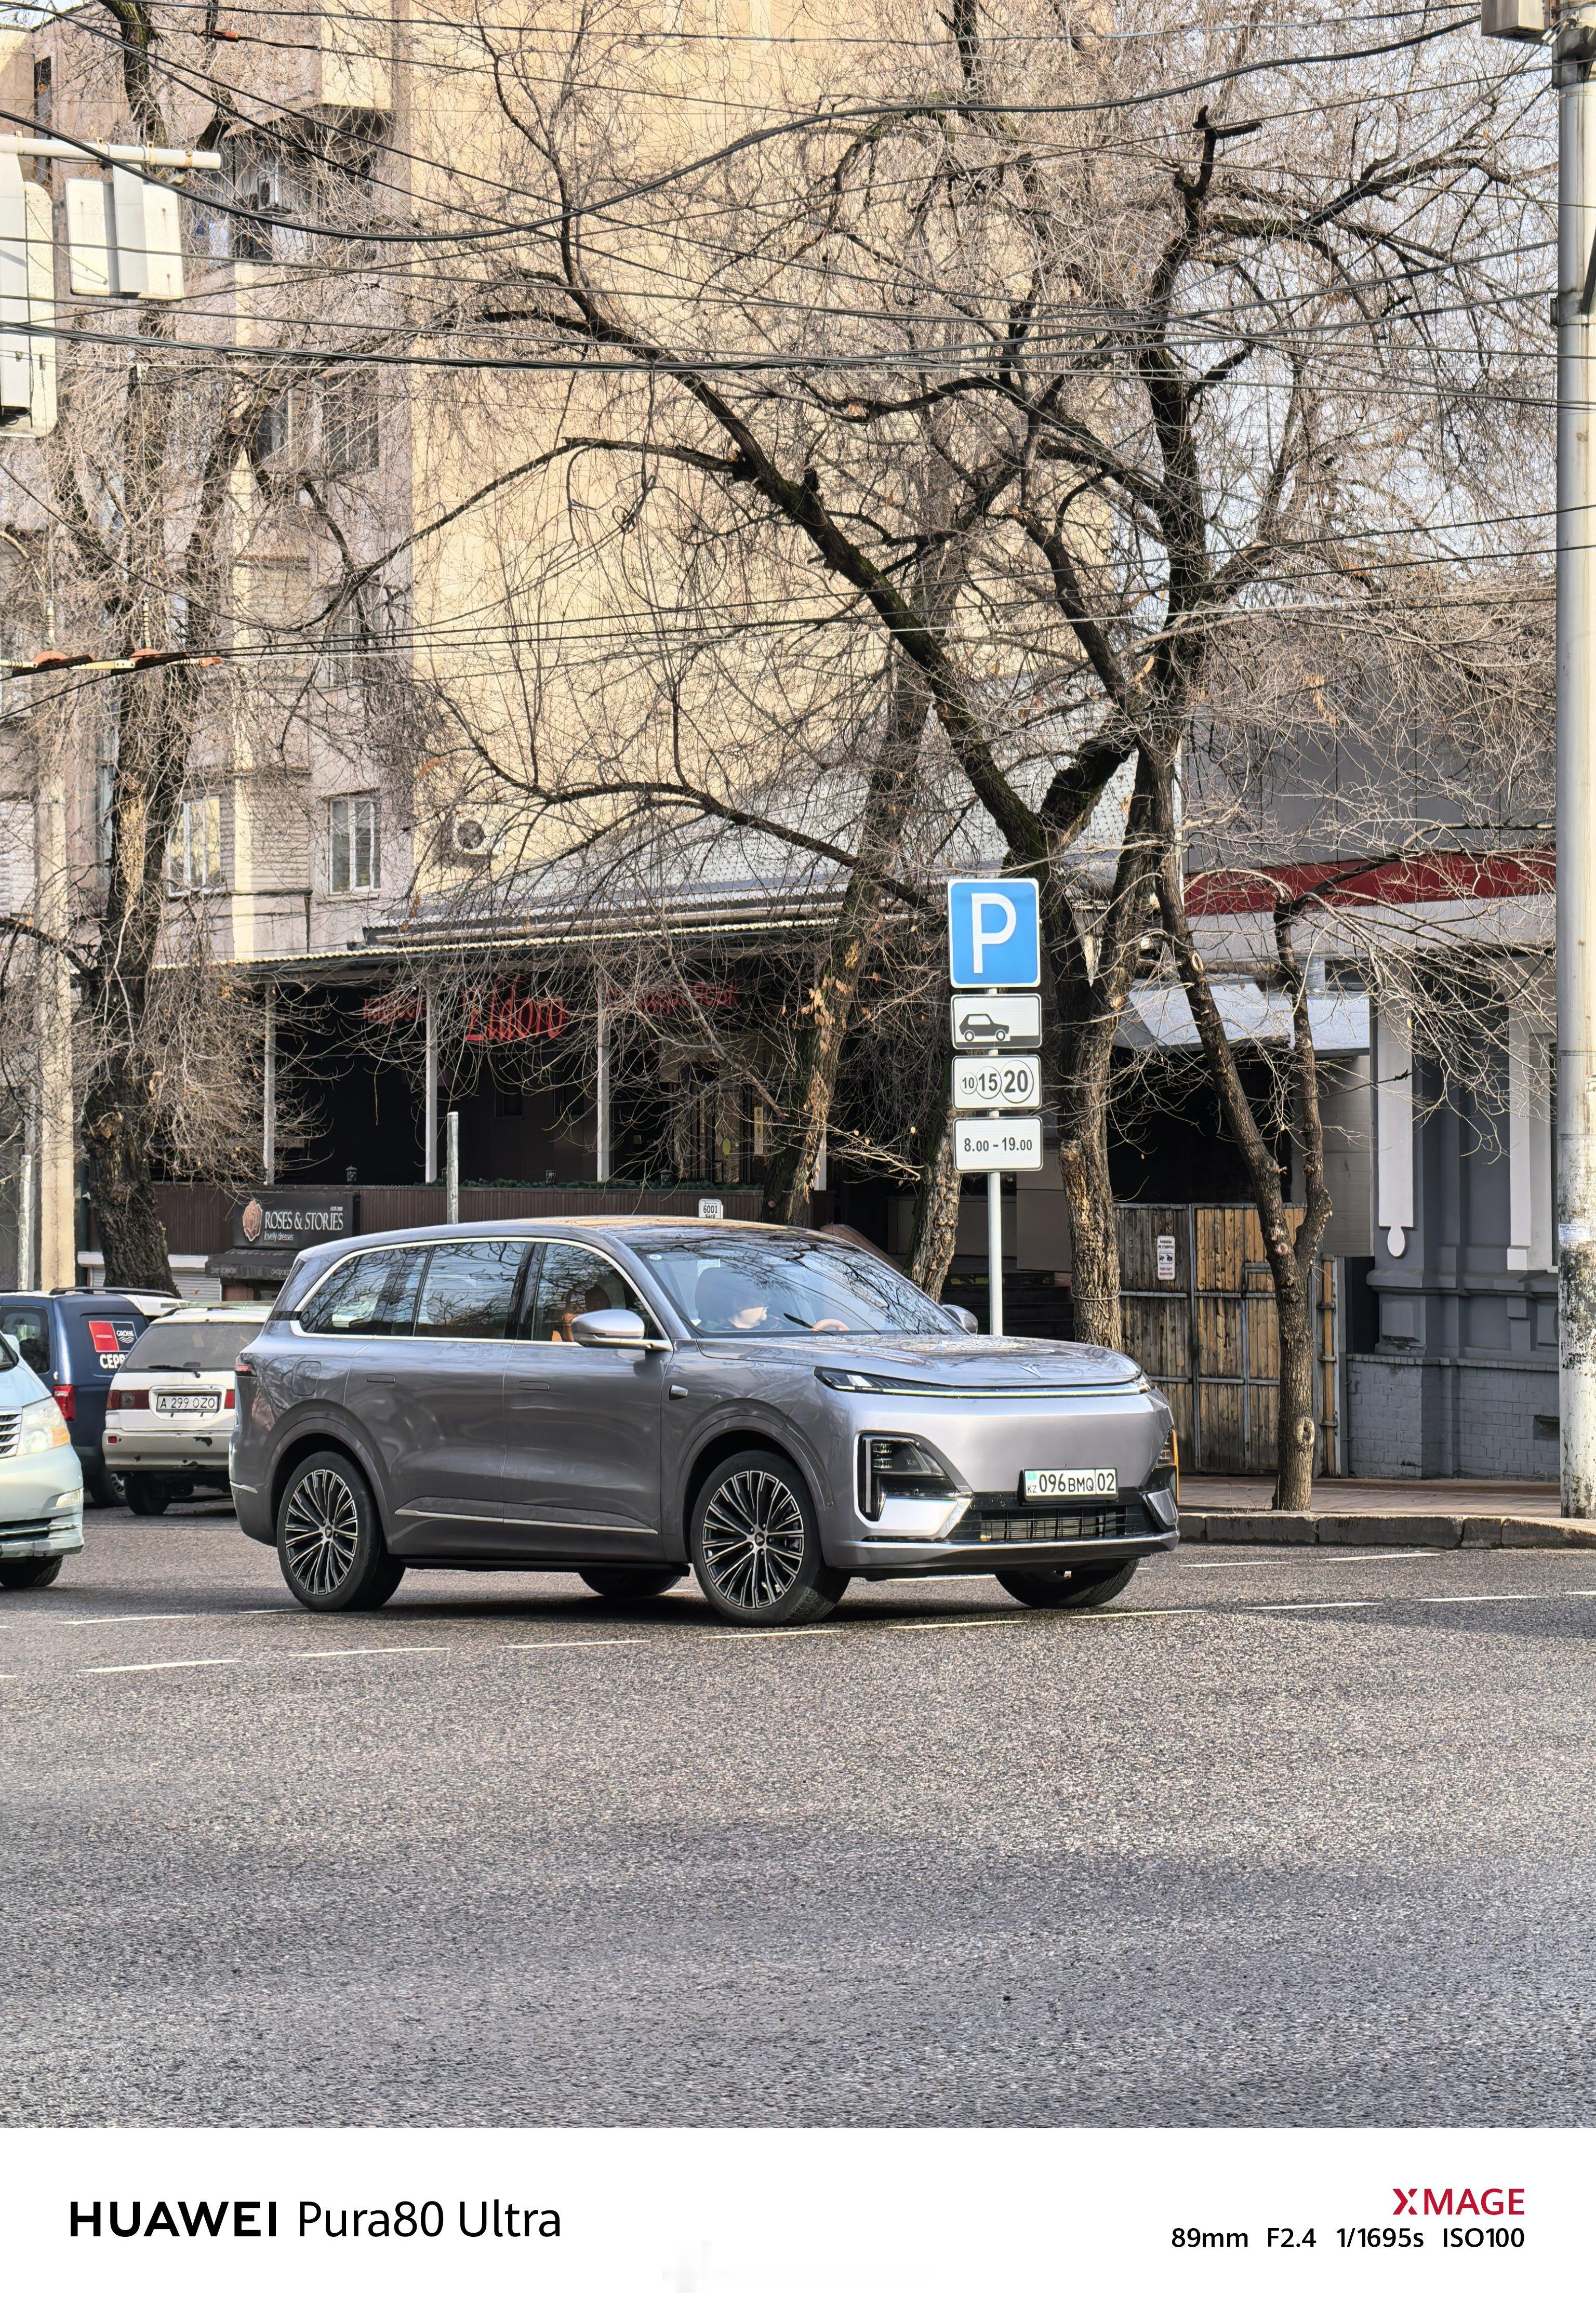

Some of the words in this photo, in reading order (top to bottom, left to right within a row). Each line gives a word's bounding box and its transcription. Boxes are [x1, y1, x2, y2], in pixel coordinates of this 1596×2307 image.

[971, 893, 1017, 974] P
[962, 1077, 975, 1089] 10
[978, 1073, 998, 1092] 15
[1004, 1069, 1029, 1093] 20
[964, 1138, 989, 1152] 8.00
[1002, 1137, 1032, 1151] 19.00
[703, 1205, 717, 1214] 6001
[264, 1211, 292, 1229] ROSES
[294, 1212, 303, 1230] &
[304, 1212, 343, 1230] STORIES
[160, 1397, 166, 1408] A
[171, 1397, 189, 1408] 299
[193, 1397, 215, 1408] OZO
[1027, 1485, 1037, 1493] KZ
